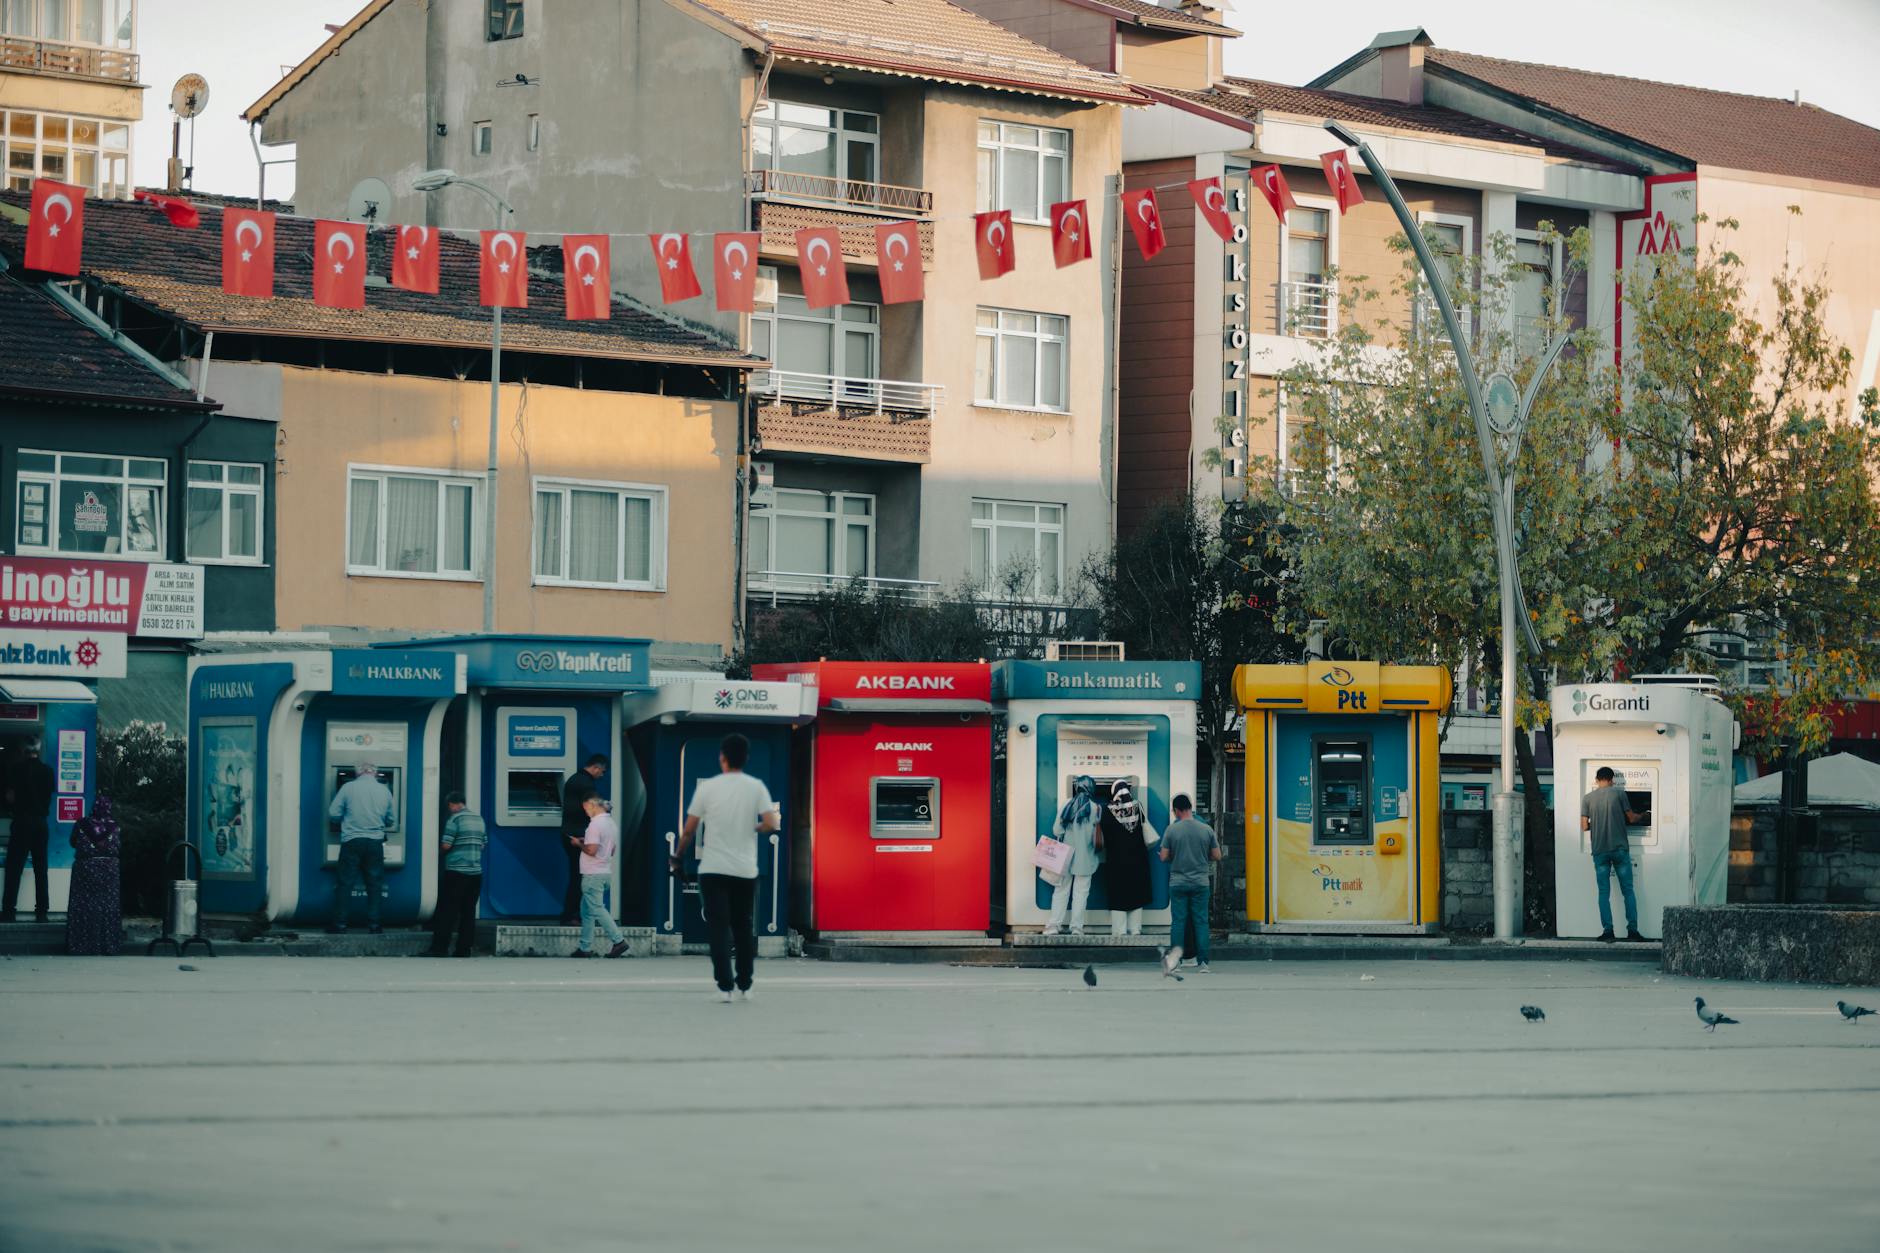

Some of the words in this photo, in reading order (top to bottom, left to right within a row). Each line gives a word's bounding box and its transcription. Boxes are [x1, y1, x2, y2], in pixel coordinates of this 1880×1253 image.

[154, 571, 170, 579] ARSA
[176, 572, 194, 580] TARLA
[176, 581, 194, 589] SATIM
[145, 594, 169, 602] SATILIK
[9, 606, 128, 624] gayrimenkul
[142, 618, 160, 629] 0530
[162, 619, 173, 629] 322
[176, 620, 184, 629] 61
[187, 620, 195, 629] 74
[556, 651, 632, 674] YapıKredi
[367, 666, 442, 681] HALKBANK
[1046, 671, 1163, 689] Bankamatik
[209, 681, 254, 699] HALKBANK
[856, 676, 955, 690] AKBANK
[736, 689, 768, 701] QNB
[1338, 689, 1367, 710] Ptt
[1590, 693, 1650, 711] Garanti
[875, 742, 933, 751] AKBANK
